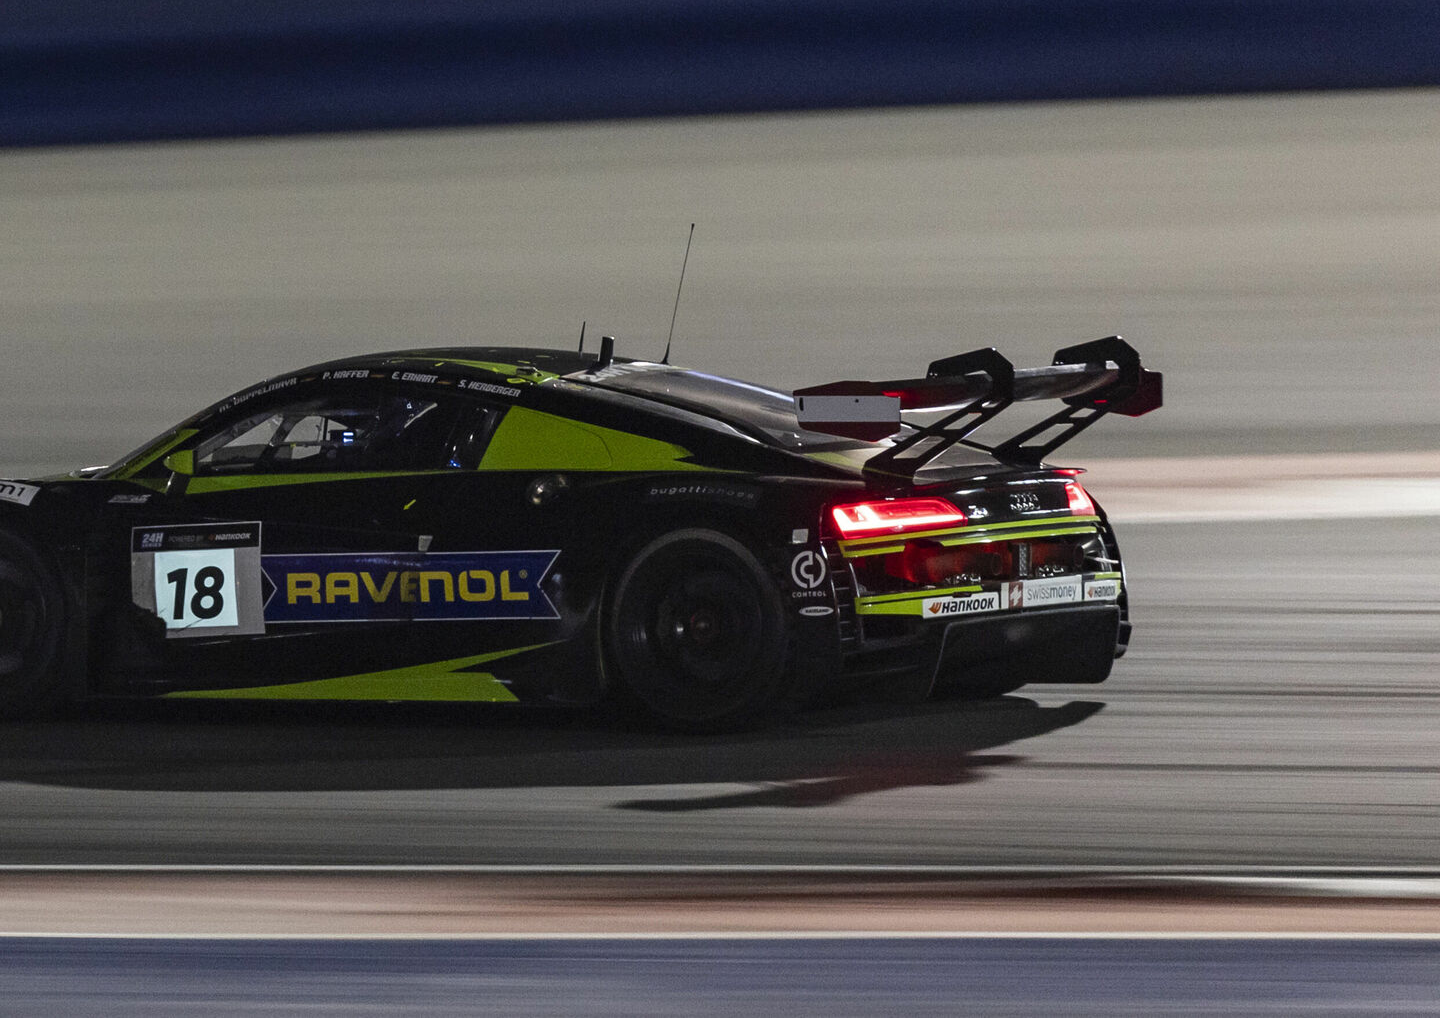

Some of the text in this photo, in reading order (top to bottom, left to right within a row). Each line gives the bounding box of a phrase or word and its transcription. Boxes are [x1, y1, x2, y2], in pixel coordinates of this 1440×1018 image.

[323, 370, 370, 379] P. HAFFER
[392, 371, 438, 383] E. ERHART
[458, 379, 521, 397] S. HERBERGER
[142, 532, 164, 543] 24H
[167, 566, 224, 620] 18
[287, 570, 529, 604] RAVENOL
[792, 590, 827, 598] CONTROL
[1027, 584, 1077, 601] swissmoney
